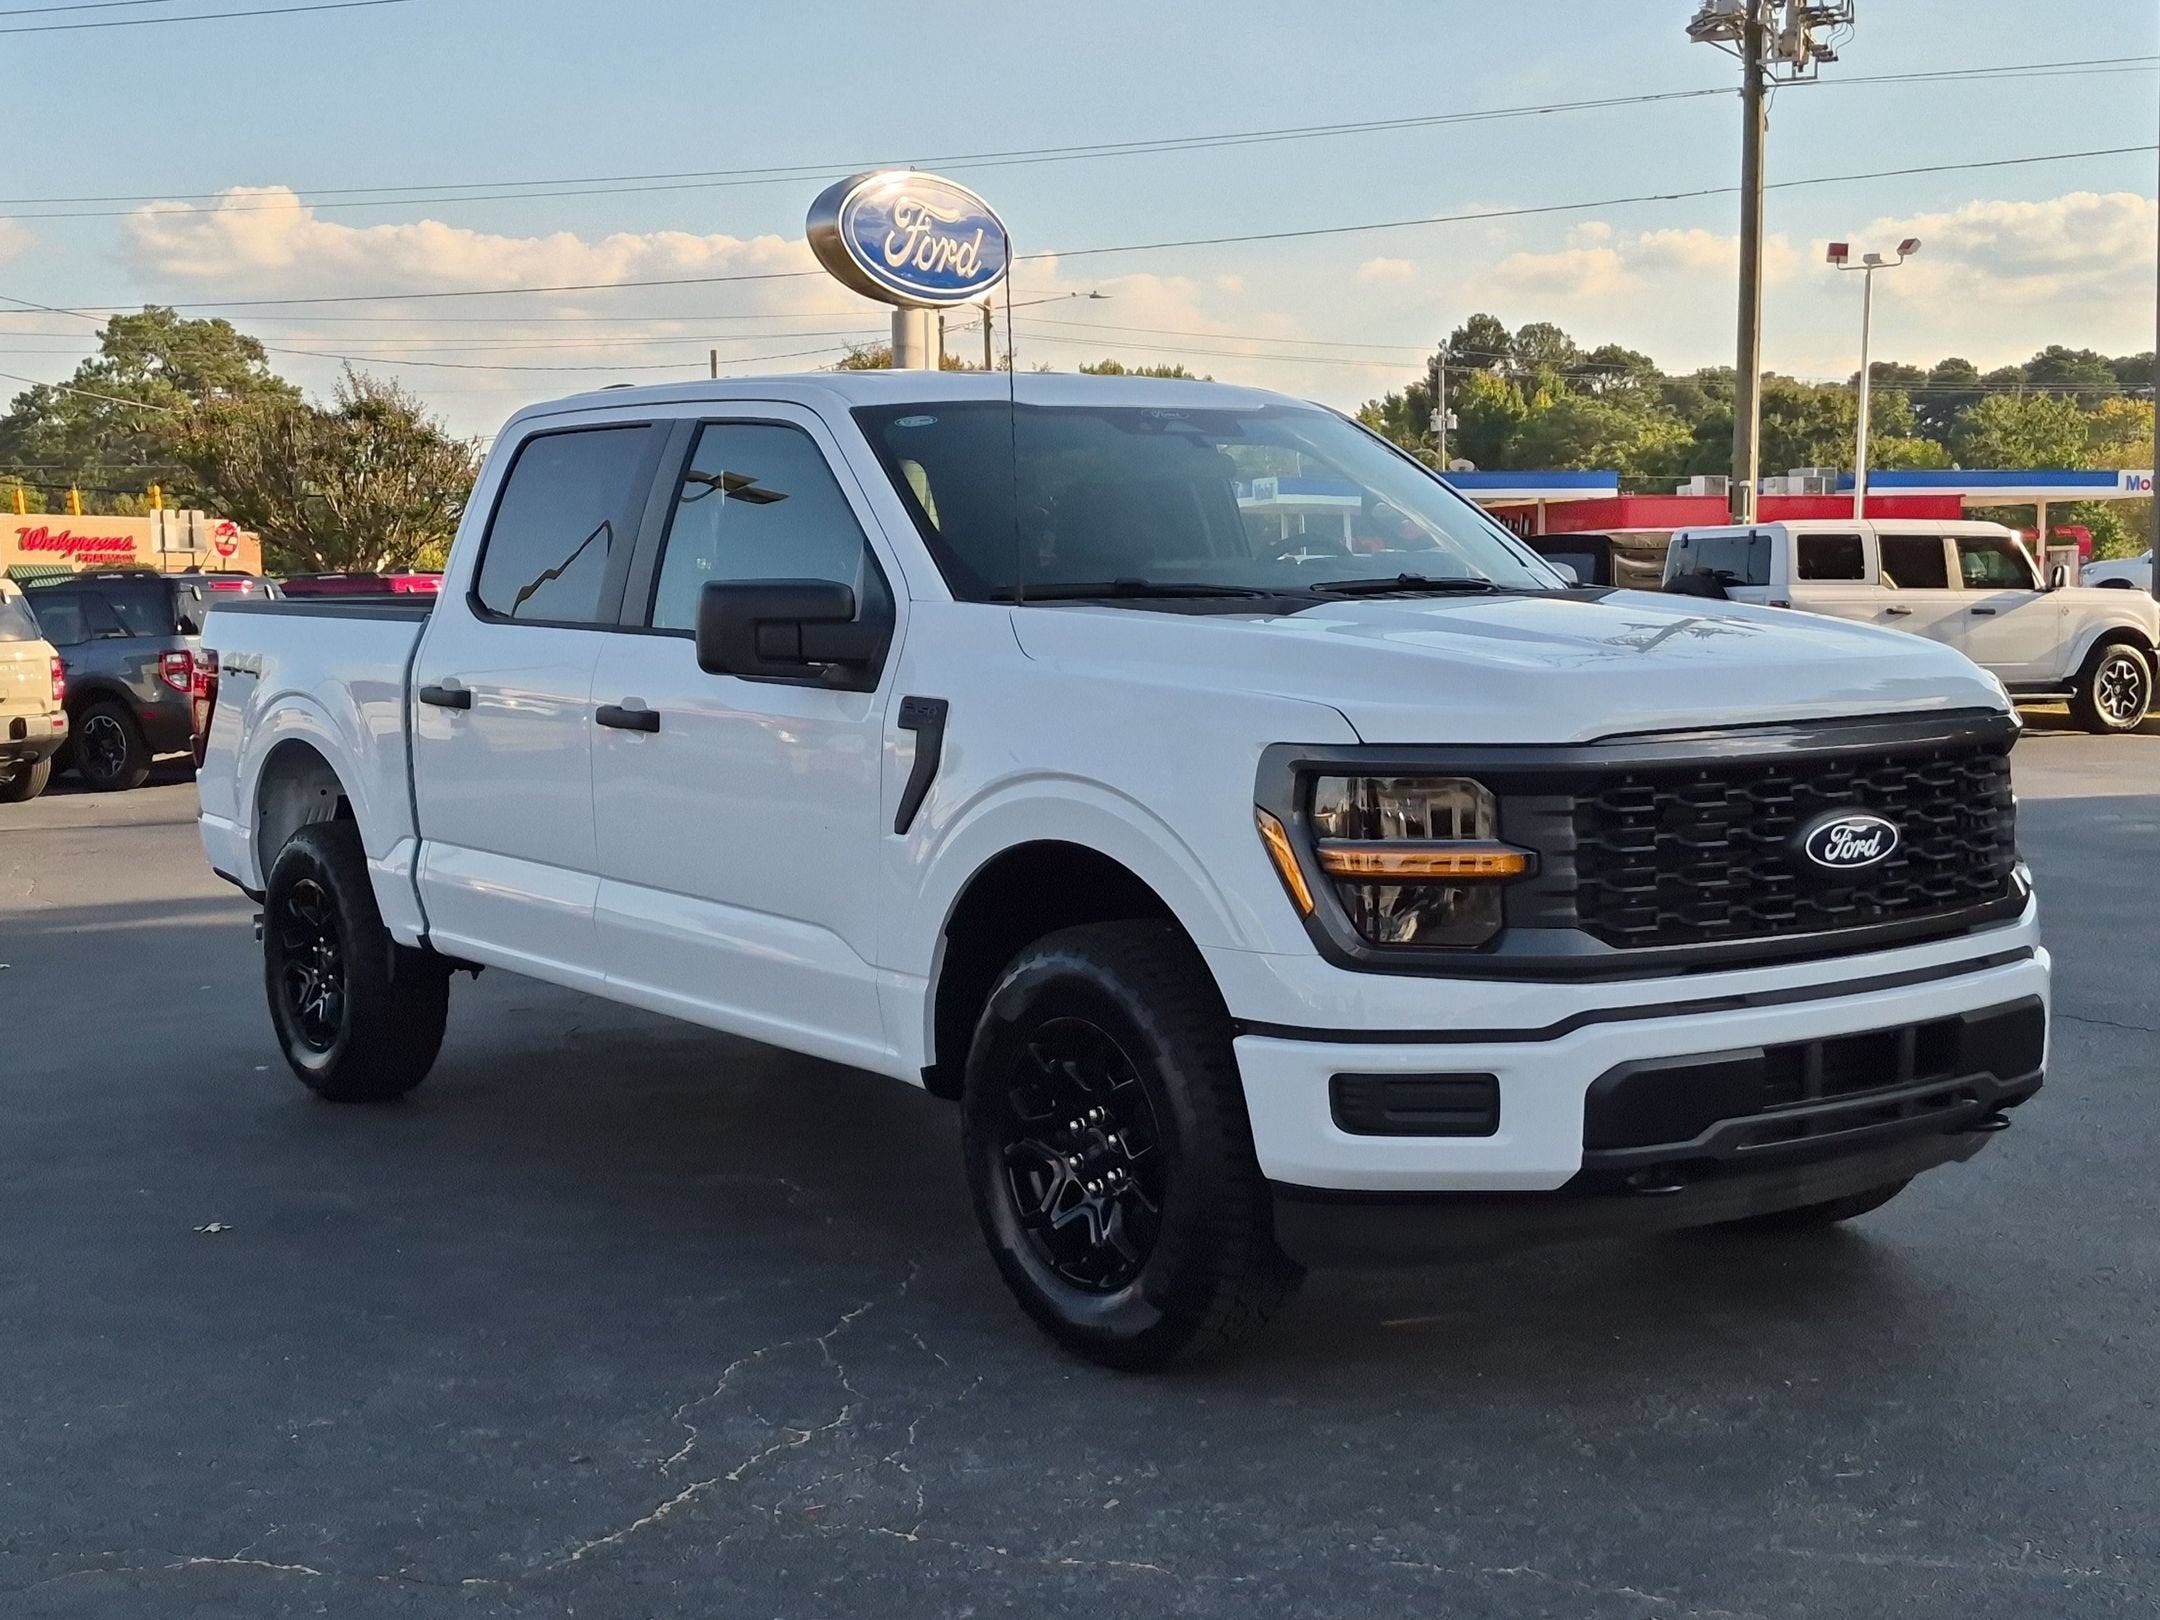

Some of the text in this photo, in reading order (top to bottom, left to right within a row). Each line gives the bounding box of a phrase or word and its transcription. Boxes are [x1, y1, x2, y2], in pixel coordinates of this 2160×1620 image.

[884, 196, 984, 279] Ford
[2126, 475, 2153, 491] Mo
[16, 526, 137, 559] Walgreens
[1824, 824, 1882, 861] Ford
